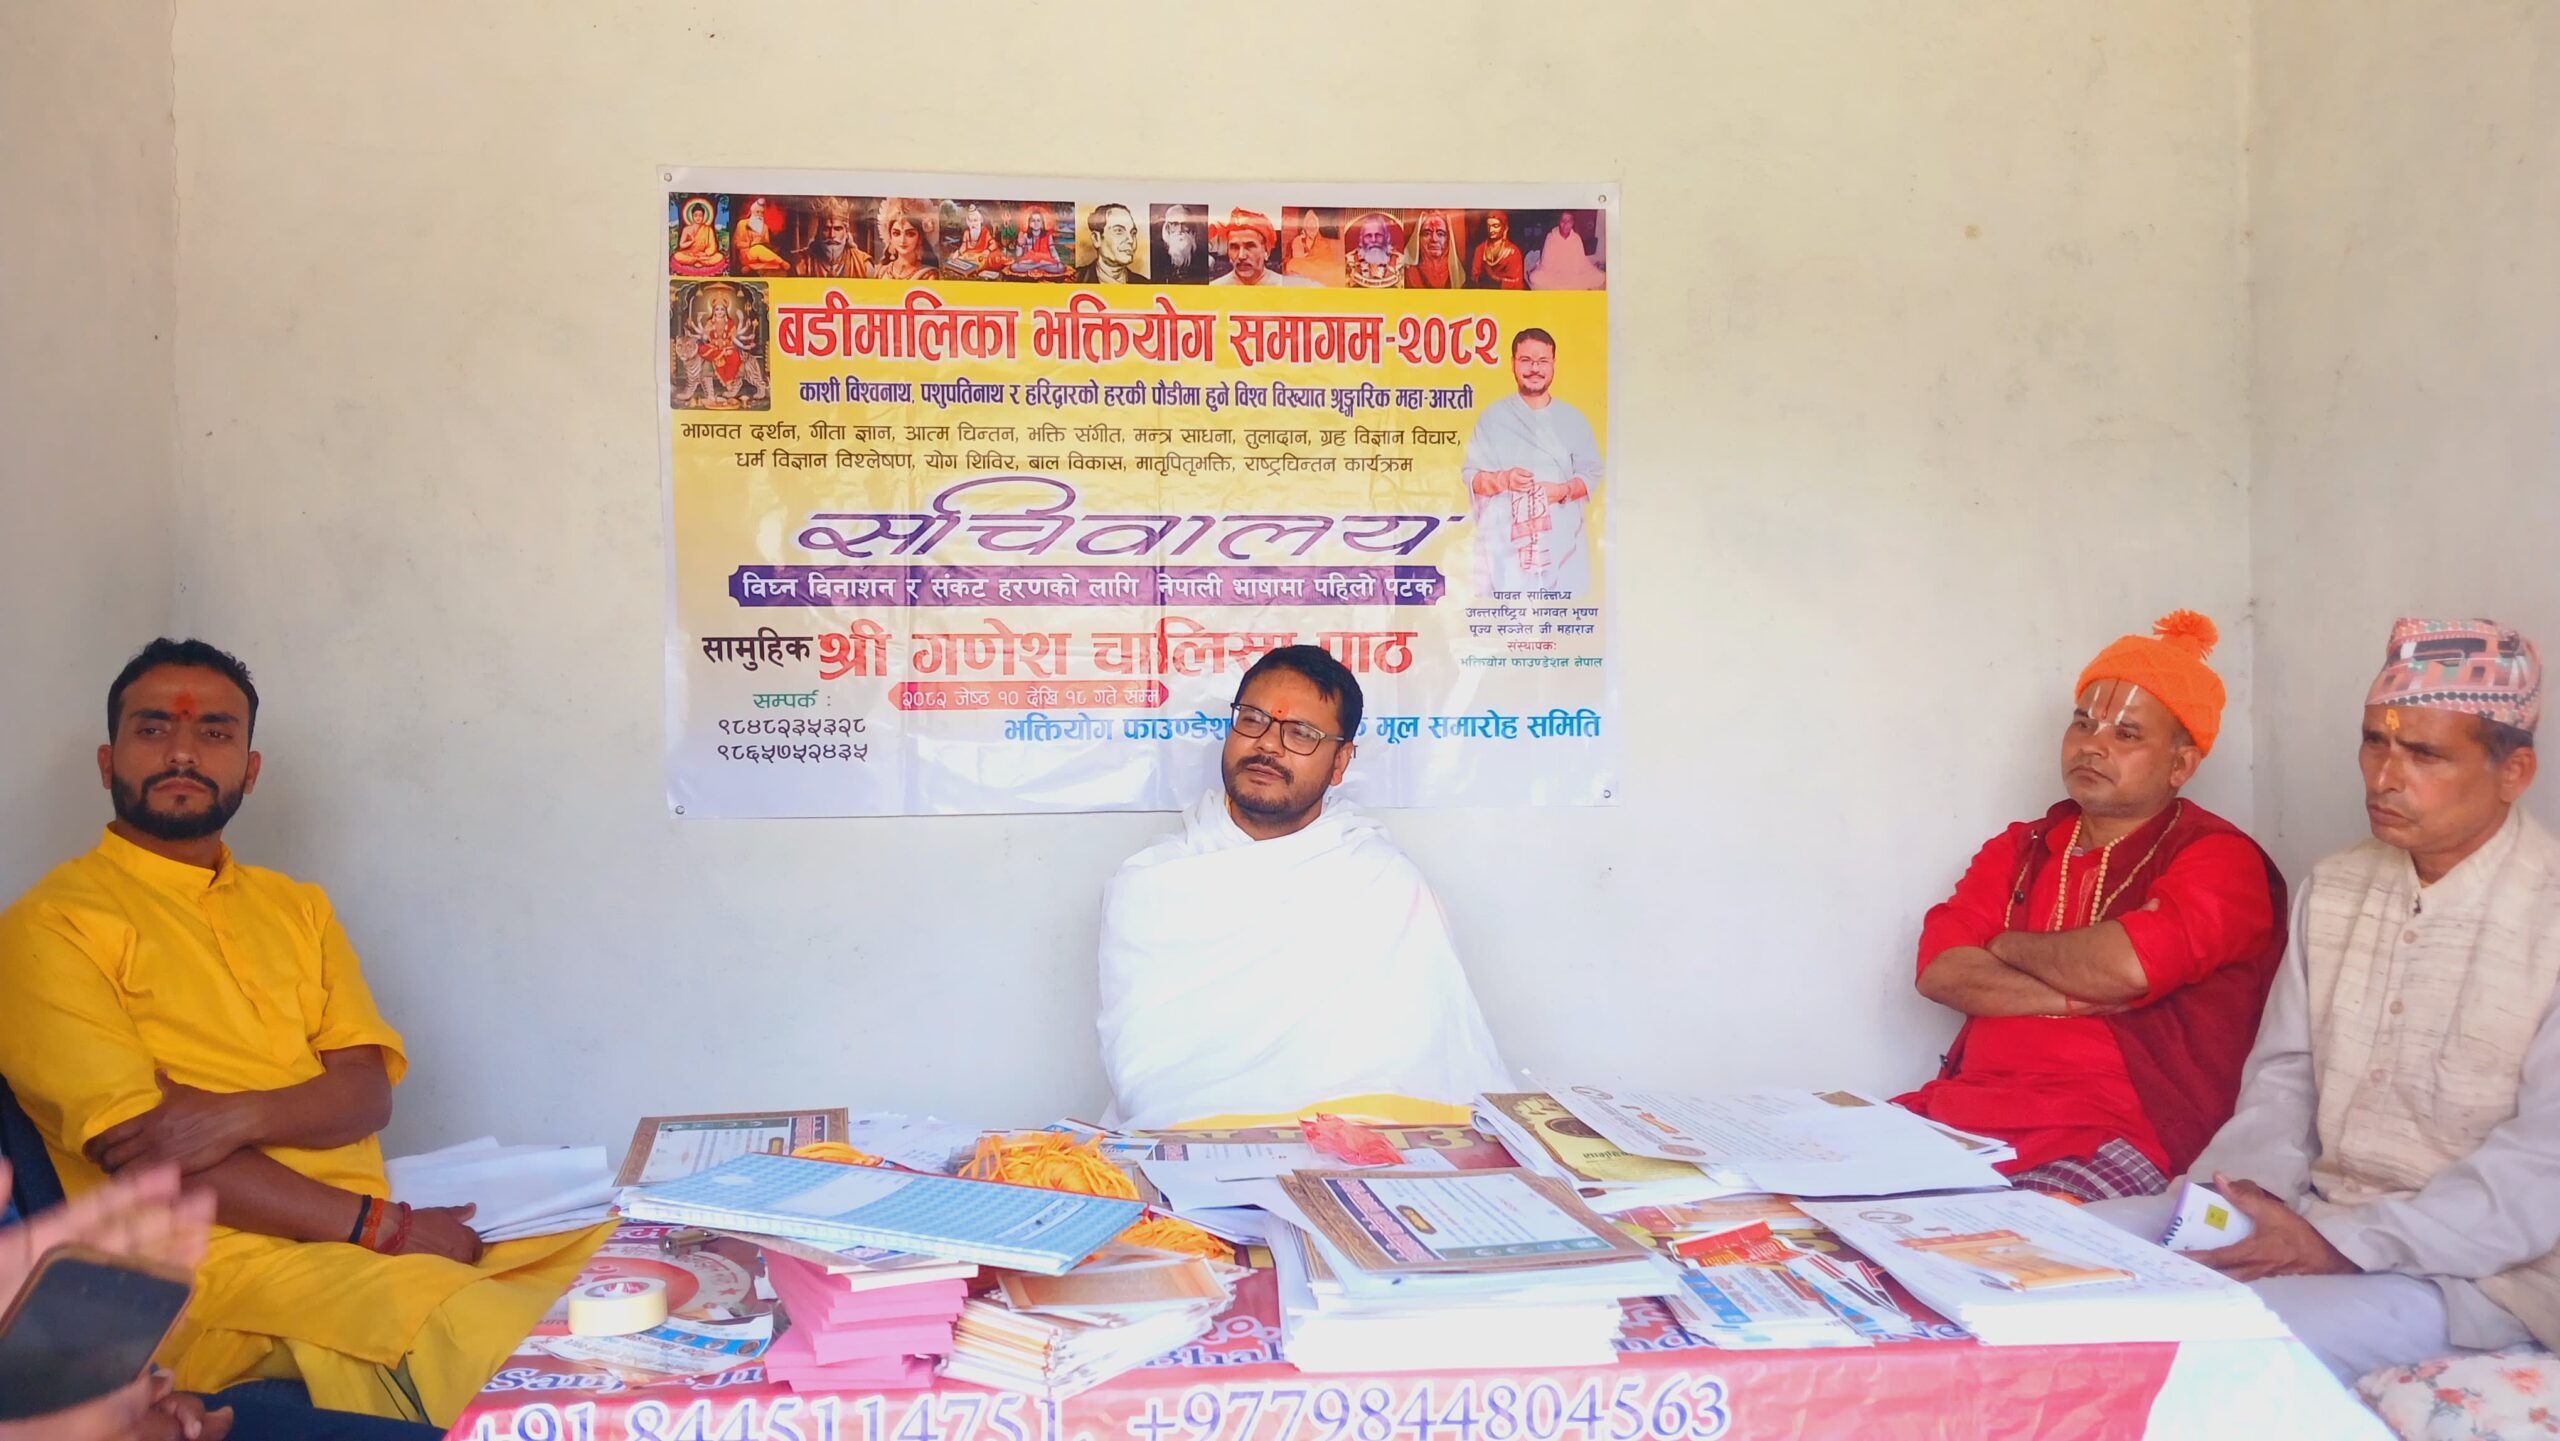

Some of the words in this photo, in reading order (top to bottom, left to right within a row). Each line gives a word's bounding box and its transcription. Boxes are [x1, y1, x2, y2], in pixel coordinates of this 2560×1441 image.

[777, 290, 1019, 361] बडीमालिका
[1033, 293, 1216, 364] भक्तियोग
[800, 375, 840, 404] काशी
[920, 376, 1004, 408] पशुपतिनाथ
[1009, 384, 1021, 405] र
[1025, 378, 1099, 409] हरिद्वारको
[1104, 380, 1146, 407] हरकी
[1152, 379, 1201, 406] पौडीमा
[1205, 381, 1230, 412] हुने
[1235, 380, 1267, 408] विश्व
[1272, 381, 1326, 409] विख्यात
[681, 423, 742, 440] भागवत
[750, 421, 800, 442] दर्शन,
[809, 419, 846, 440] गीता
[853, 425, 896, 443] ज्ञान,
[905, 426, 950, 442] आत्म
[957, 421, 1019, 443] चिन्तन,
[1027, 422, 1067, 442] भक्ति
[1074, 423, 1125, 443] संगीत,
[1133, 428, 1173, 444] मन्त्र
[1180, 428, 1236, 445] साधना,
[1243, 429, 1311, 449] तुलादान,
[1320, 430, 1347, 447] ग्रह
[1354, 425, 1405, 447] विज्ञान
[1412, 426, 1461, 447] विचार,
[735, 449, 767, 469] धर्म
[773, 448, 827, 470] विज्ञान
[836, 448, 916, 470] विश्लेषण,
[923, 450, 958, 470] योग
[965, 450, 1019, 471] शिविर,
[1027, 455, 1060, 471] बाल
[1067, 451, 1126, 472] विकास,
[1134, 451, 1236, 476] मातृपितृभक्ति,
[1243, 452, 1337, 476] राष्ट्रचिन्तन
[1343, 454, 1414, 473] कार्यक्रम
[797, 475, 1450, 560] सचिवालय
[741, 571, 799, 599] विघ्न
[808, 571, 896, 600] विनाशन
[905, 577, 922, 600] र
[931, 571, 989, 599] संकट
[998, 571, 1079, 601] हरणको
[1088, 572, 1140, 598] लागि
[1158, 571, 1223, 599] नेपाली
[1232, 576, 1304, 599] भाषामा
[1314, 571, 1376, 601] पहिलो
[1384, 576, 1437, 599] पटक
[1469, 624, 1493, 637] पूज्य
[1539, 621, 1552, 634] जी
[1557, 624, 1595, 636] महाराज
[1532, 607, 1568, 618] भागवत
[1572, 607, 1600, 621] भूषण
[701, 626, 814, 671] सामुहिक
[818, 617, 893, 681] श्री
[911, 617, 1072, 679] गणेश
[1091, 615, 1298, 677] चालिस
[1574, 655, 1604, 667] नेपाल
[752, 689, 820, 709] सम्पर्क
[1027, 685, 1059, 707] देखि
[1122, 710, 1232, 741] फाउण्डेश
[1375, 715, 1420, 744] मूल
[1428, 709, 1520, 741] समारोह
[1527, 707, 1602, 739] समिति
